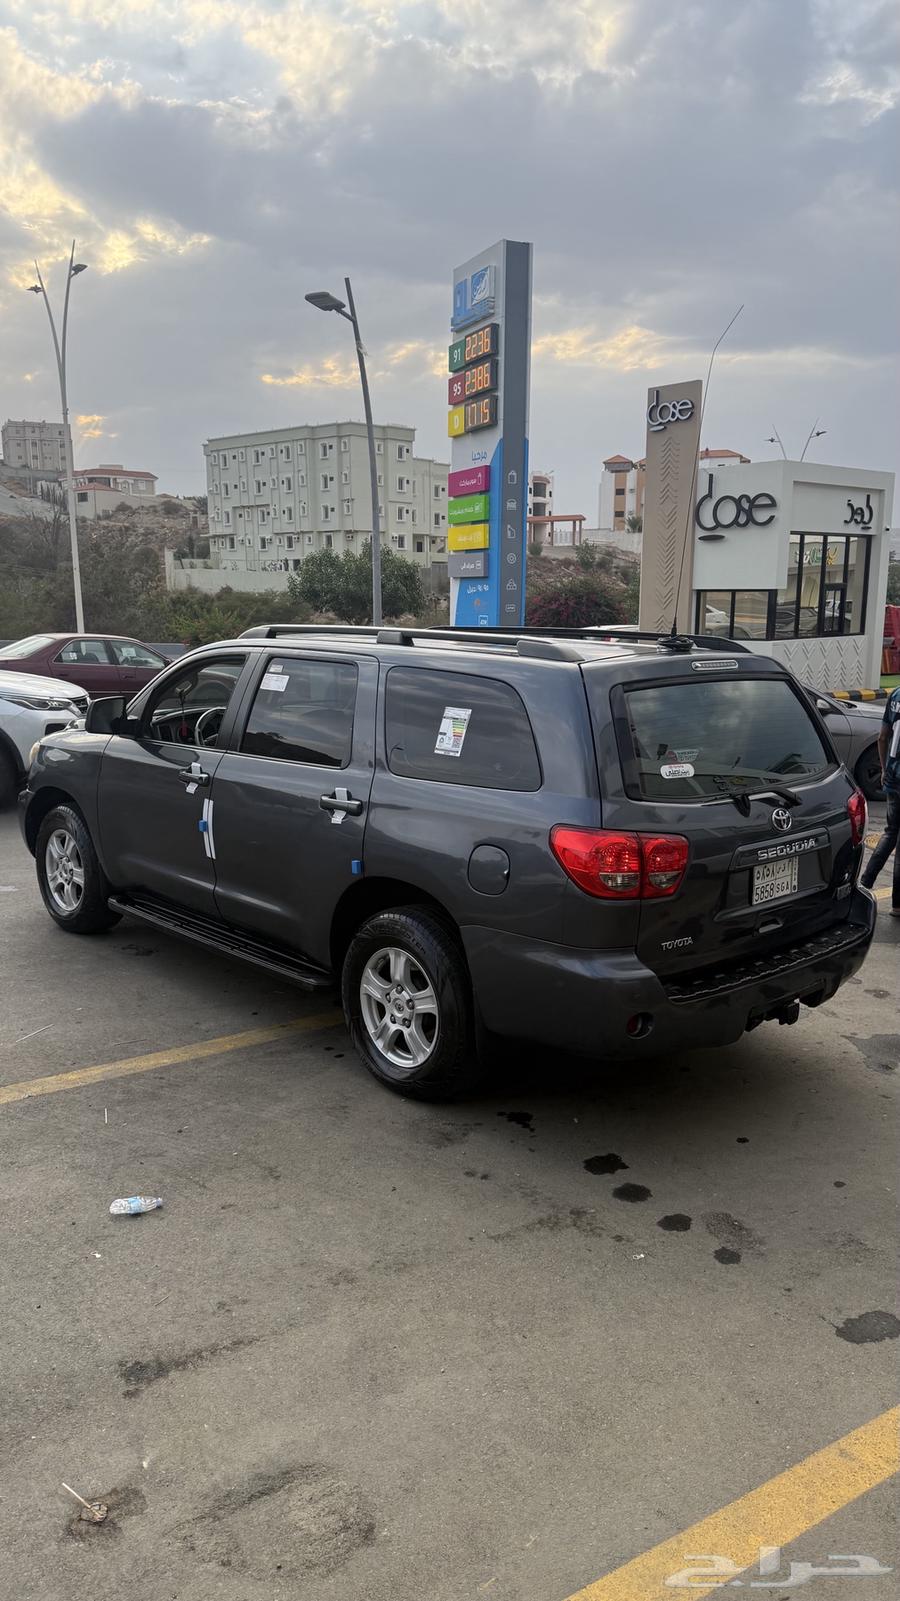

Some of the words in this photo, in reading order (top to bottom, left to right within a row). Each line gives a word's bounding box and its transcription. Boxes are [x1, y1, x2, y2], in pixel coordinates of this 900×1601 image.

[454, 348, 461, 362] 91
[453, 382, 461, 396] 95
[648, 390, 694, 432] dose
[695, 473, 777, 541] dose
[757, 838, 817, 860] SEQUOIA
[755, 882, 775, 902] 5858
[661, 936, 694, 951] TOYOTA
